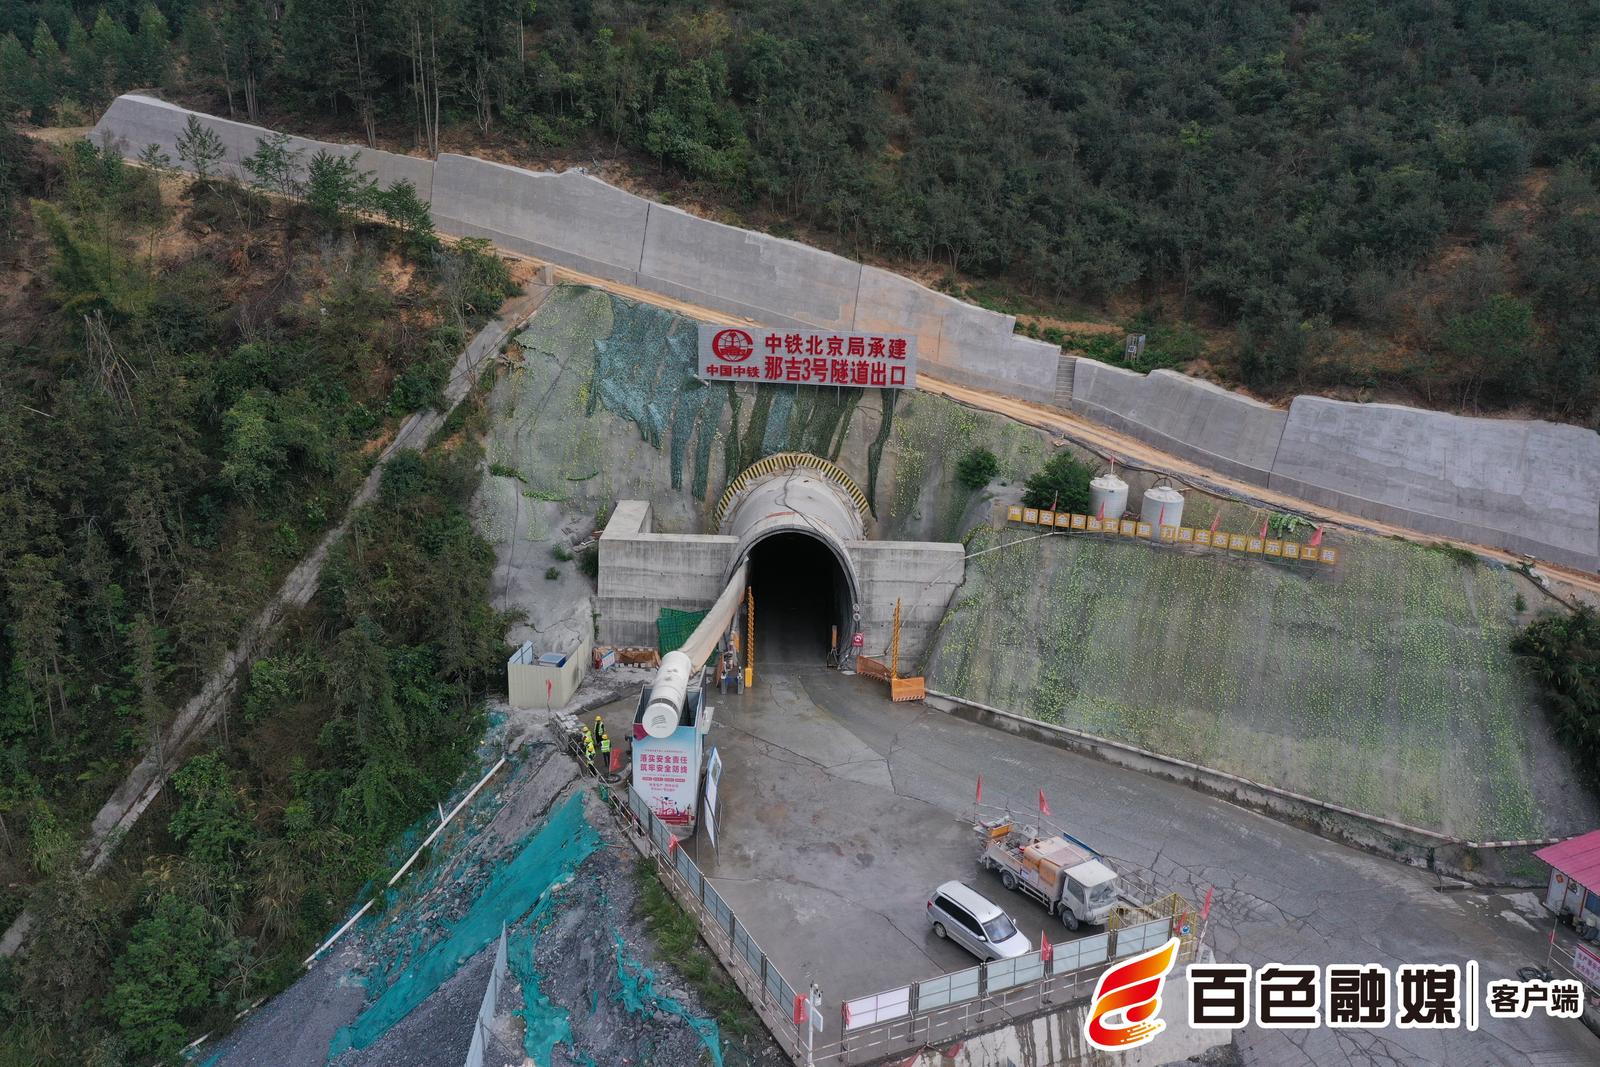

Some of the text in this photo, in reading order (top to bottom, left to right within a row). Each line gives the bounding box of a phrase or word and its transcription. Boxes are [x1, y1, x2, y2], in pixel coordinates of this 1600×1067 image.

[765, 333, 907, 360] 中铁北京局承建
[706, 364, 760, 378] 中国中铁
[764, 355, 906, 386] 那吉3号隧道出口
